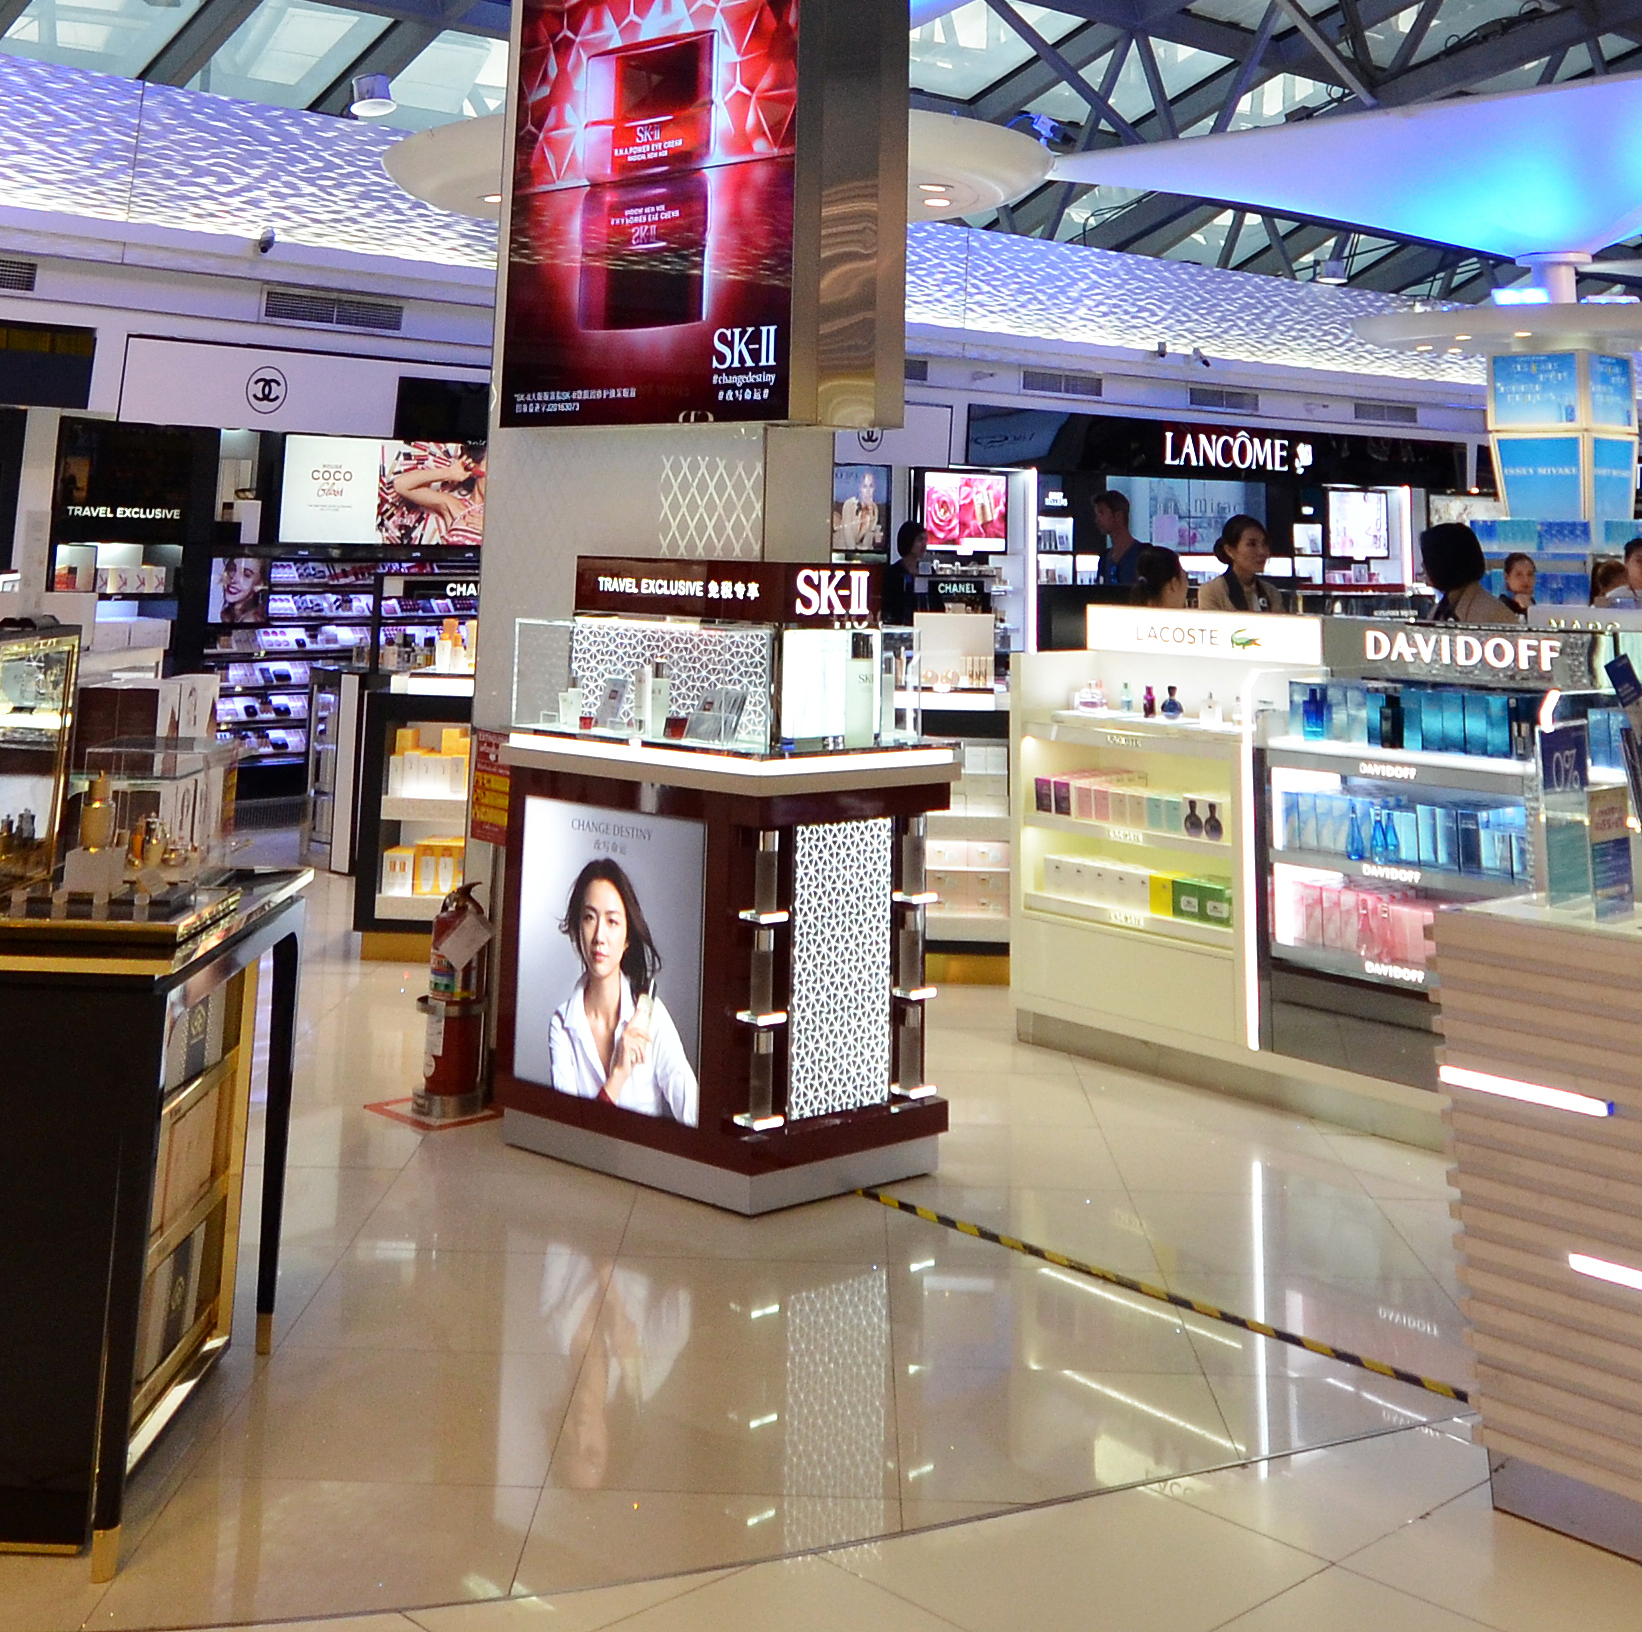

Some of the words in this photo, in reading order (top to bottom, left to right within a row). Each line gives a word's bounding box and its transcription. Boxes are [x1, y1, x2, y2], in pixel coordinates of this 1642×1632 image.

[712, 325, 778, 369] SK-II
[1164, 430, 1289, 471] LANCÔME
[311, 469, 353, 482] COCO
[67, 505, 114, 519] TRAVEL
[116, 506, 181, 520] EXCLUSIVE
[598, 576, 638, 594] TRAVEL
[641, 578, 704, 597] EXCLUSIVE
[795, 568, 870, 616] SK-II
[937, 581, 977, 594] CHANEL
[1136, 625, 1219, 647] LACOSTE
[1365, 629, 1562, 671] DAVIDOFF
[1358, 762, 1417, 780] DAVIDOFF
[1552, 748, 1580, 792] 0%
[571, 818, 611, 835] CHANGE
[613, 823, 653, 841] DESTINY
[1362, 864, 1421, 883] DAVIDOFF
[1364, 960, 1426, 984] DAVIDOFF
